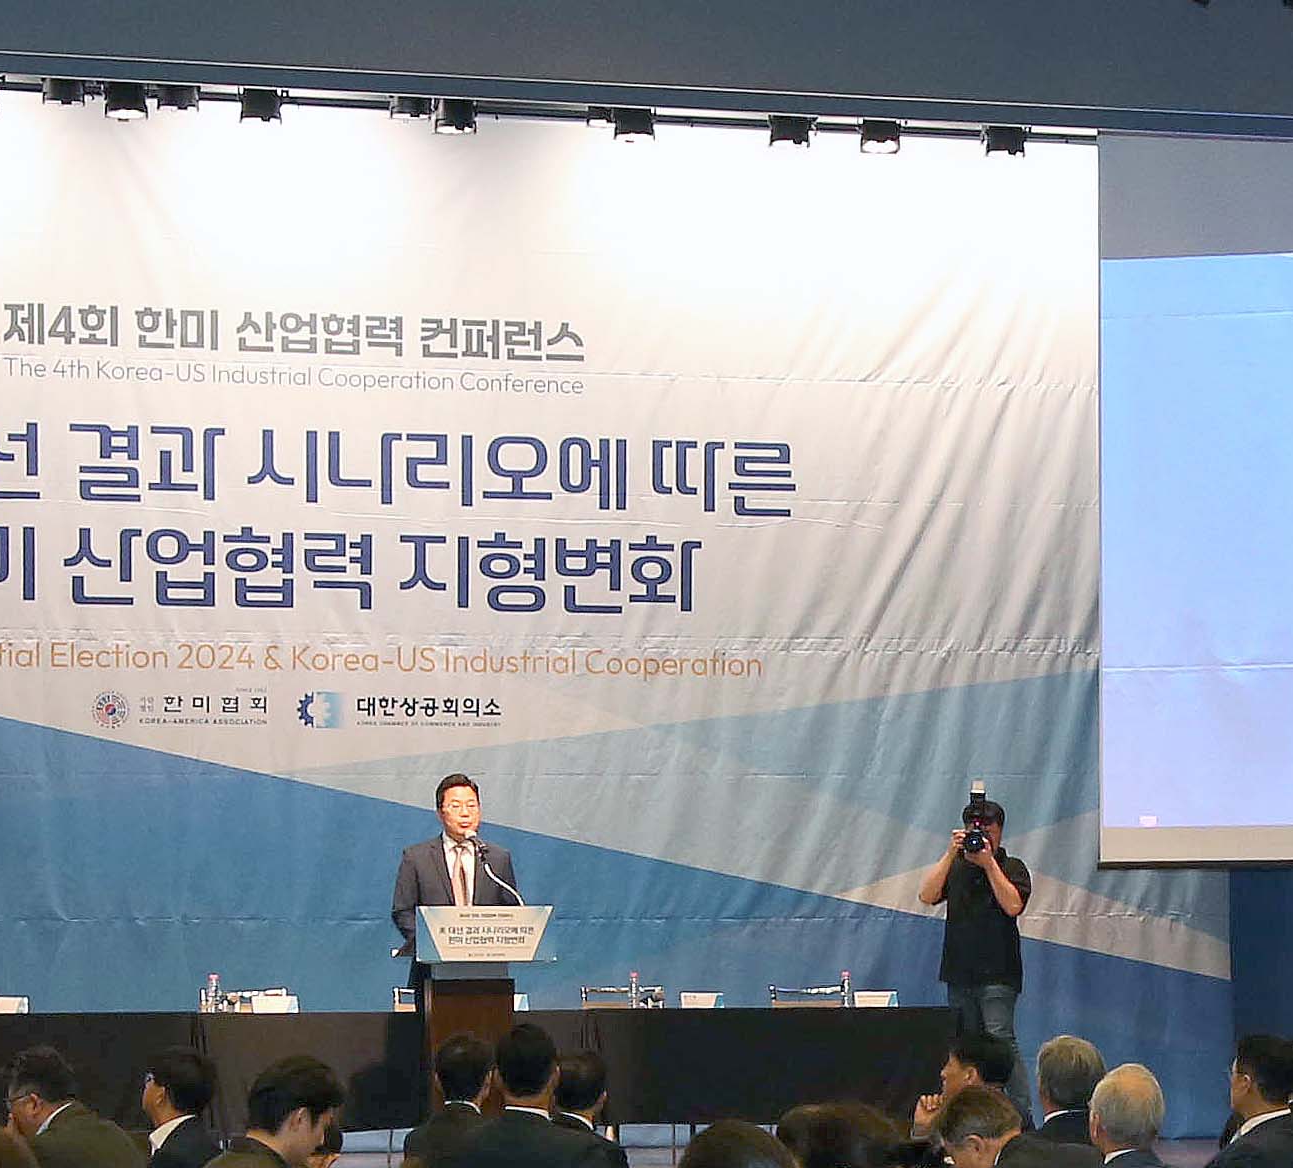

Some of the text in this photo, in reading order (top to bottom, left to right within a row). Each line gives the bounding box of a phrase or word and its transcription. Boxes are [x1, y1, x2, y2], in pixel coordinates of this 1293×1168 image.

[4, 303, 584, 361] 제4회 한미 산업협력 컨퍼런스
[3, 357, 584, 394] The 4th Korea-US Industrial Cooperation Conference
[69, 421, 225, 502] 결과
[247, 429, 627, 511] 시나리오에
[652, 439, 796, 517] 따른
[64, 526, 372, 610] 산업협력
[399, 532, 702, 614] 지형변화
[50, 642, 168, 669] Election
[177, 644, 254, 670] 2024
[263, 645, 282, 670] &
[292, 645, 434, 672] Korea-US
[444, 648, 576, 675] Industrial
[586, 649, 762, 681] Cooperation
[357, 697, 501, 717] 대한상공회의소
